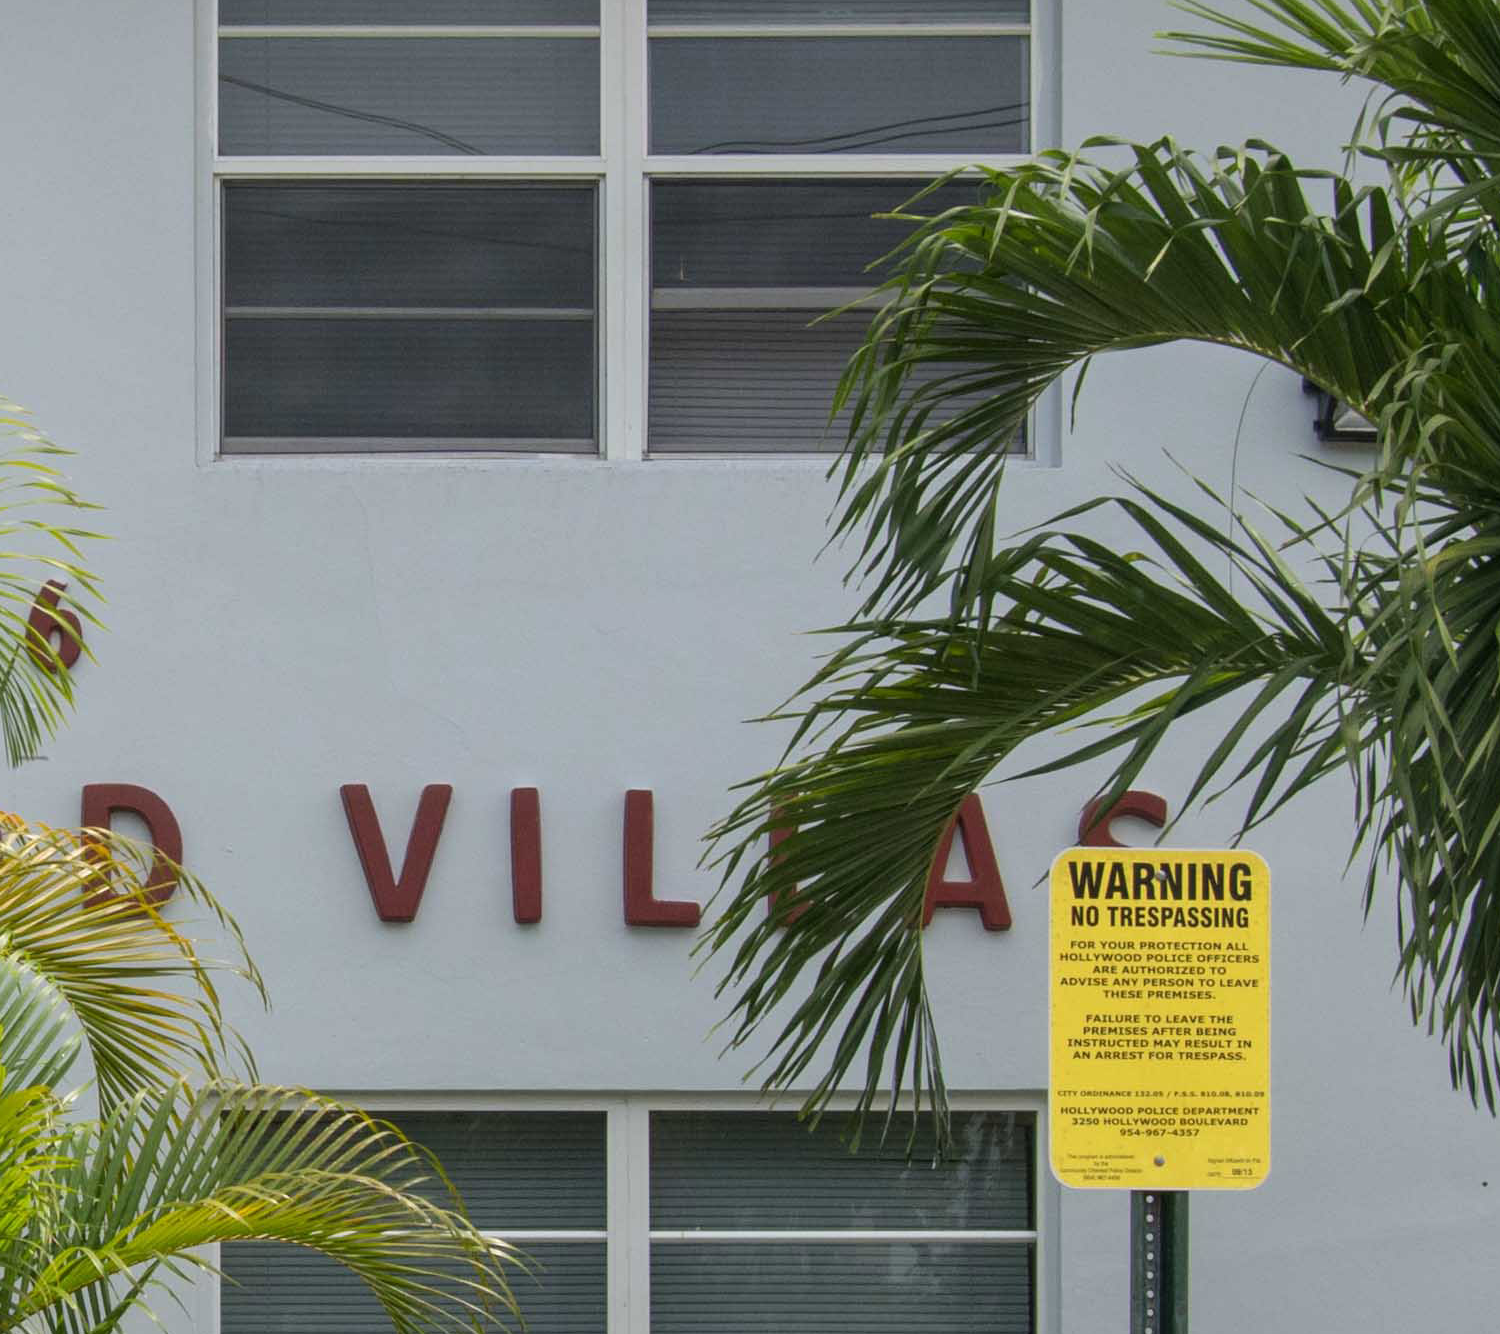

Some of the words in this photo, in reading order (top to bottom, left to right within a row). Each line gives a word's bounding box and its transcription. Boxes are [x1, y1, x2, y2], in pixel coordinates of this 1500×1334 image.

[1069, 862, 1251, 901] WARNING
[1072, 906, 1099, 926] NO
[1107, 907, 1248, 928] TRESPASSING
[1071, 941, 1095, 949] FOR
[1100, 941, 1135, 949] YOUR
[1140, 942, 1221, 950] PROTECTION
[1226, 943, 1248, 951] ALL
[1060, 953, 1142, 962] HOLLYWOOD
[1147, 954, 1192, 962] POLICE
[1197, 955, 1259, 963] OFFICERS
[1093, 966, 1117, 974] ARE
[1122, 966, 1205, 975] AUTHORIZED
[1209, 967, 1226, 975] TO
[1061, 978, 1108, 986] ADVISE
[1113, 978, 1138, 986] ANY
[1143, 978, 1193, 987] PERSON
[1198, 979, 1215, 987] TO
[1220, 979, 1258, 987] LEAVE
[1104, 990, 1142, 998] THESE
[1148, 991, 1215, 999] PREMISES.
[1086, 1015, 1140, 1023] FAILURE
[1144, 1015, 1161, 1023] TO
[1166, 1015, 1204, 1023] LEAVE
[1209, 1016, 1232, 1024] THE
[1083, 1027, 1147, 1035] PREMISES
[1152, 1027, 1191, 1035] AFTER
[1196, 1028, 1236, 1036] BEING
[1068, 1039, 1149, 1047] INSTRUCTED
[1185, 1040, 1232, 1048] RESULT
[1237, 1040, 1251, 1048] IN
[1073, 1051, 1090, 1059] AN
[1095, 1051, 1144, 1059] ARREST
[1149, 1051, 1173, 1059] FOR
[1178, 1052, 1245, 1060] TRESPASS.
[1057, 1090, 1077, 1098] CITY
[1061, 1107, 1133, 1115] HOLLYWOOD
[1138, 1107, 1178, 1115] POLICE
[1183, 1107, 1258, 1115] DEPARTMENT
[1104, 1118, 1176, 1126] HOLLYWOOD
[1180, 1118, 1248, 1126] BOULEVARD
[1120, 1128, 1199, 1136] 954-967-4357
